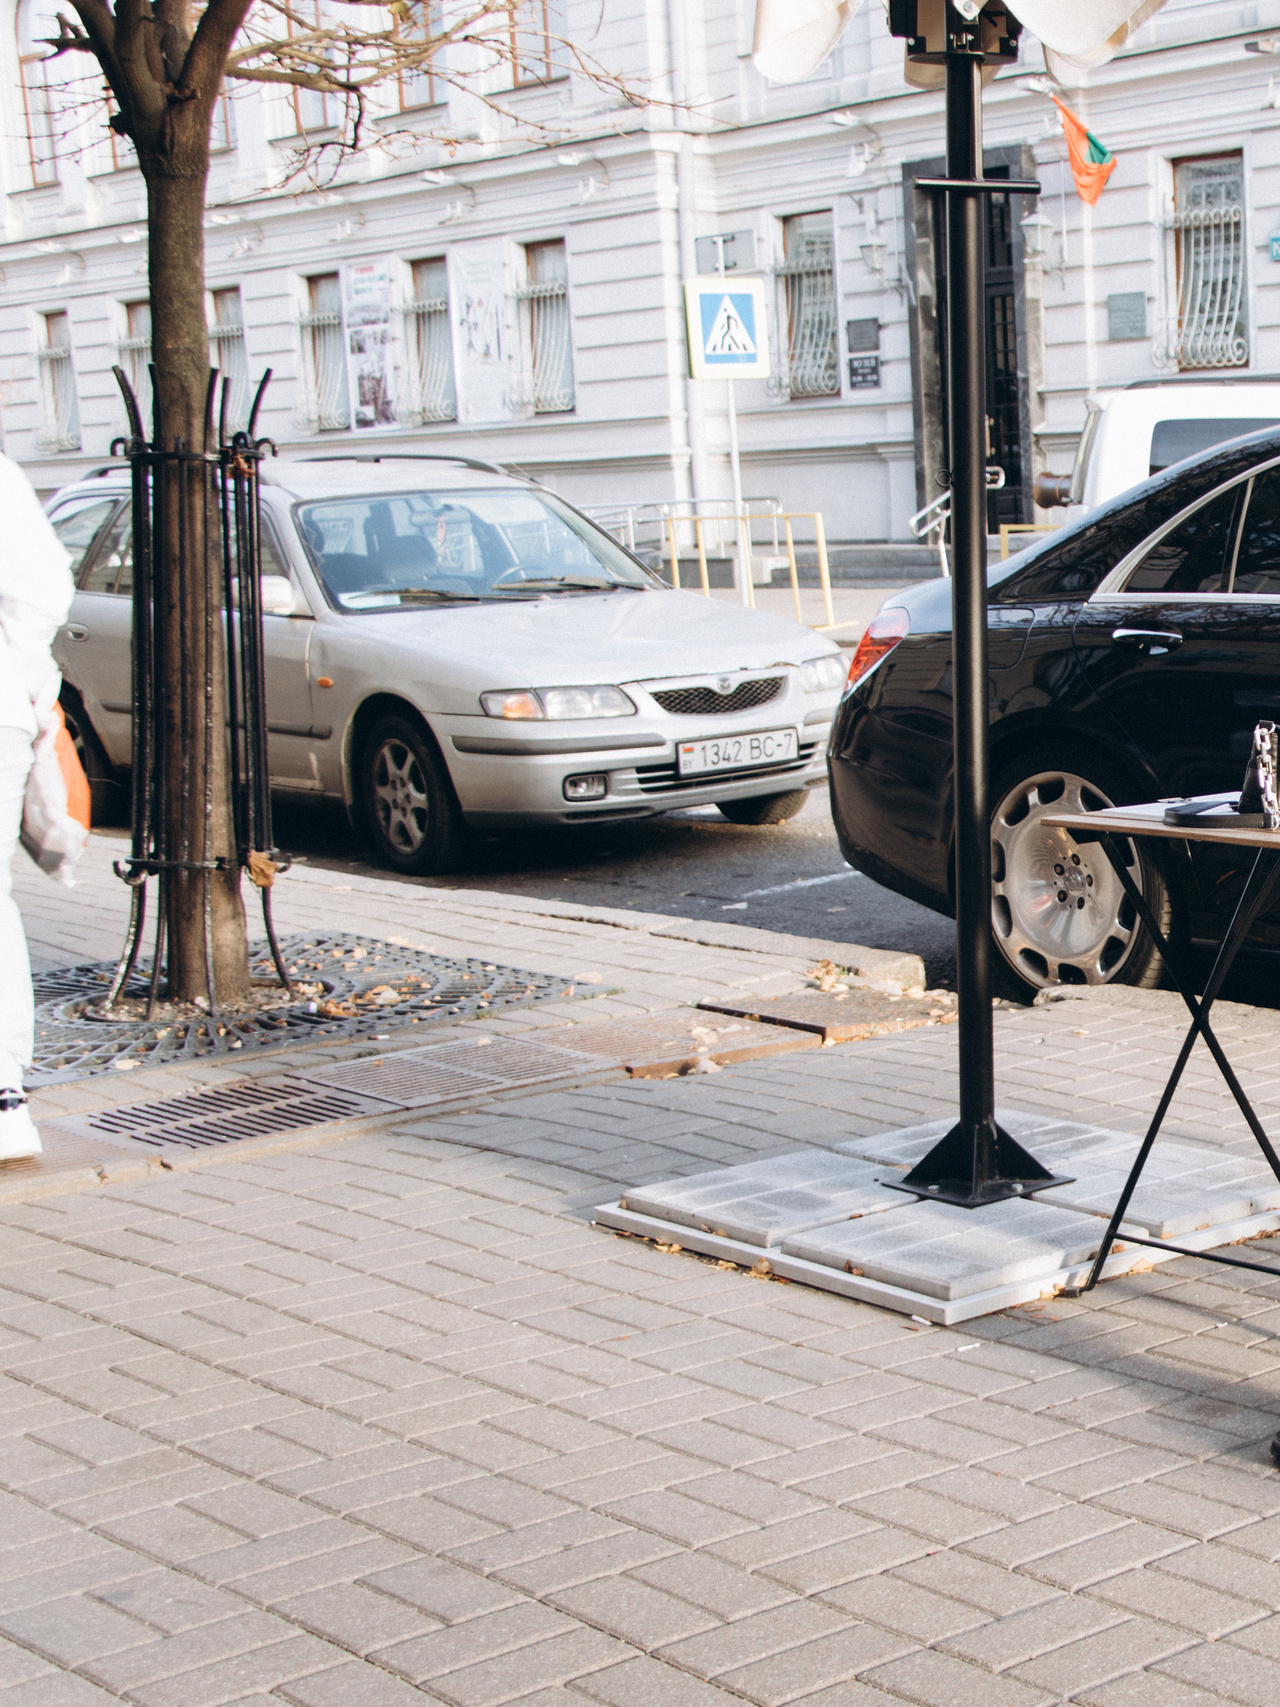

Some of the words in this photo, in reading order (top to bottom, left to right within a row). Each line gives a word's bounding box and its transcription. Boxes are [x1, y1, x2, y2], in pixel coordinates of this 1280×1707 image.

[701, 740, 742, 767] 1342
[750, 733, 793, 760] BC-7
[683, 760, 693, 770] BY
